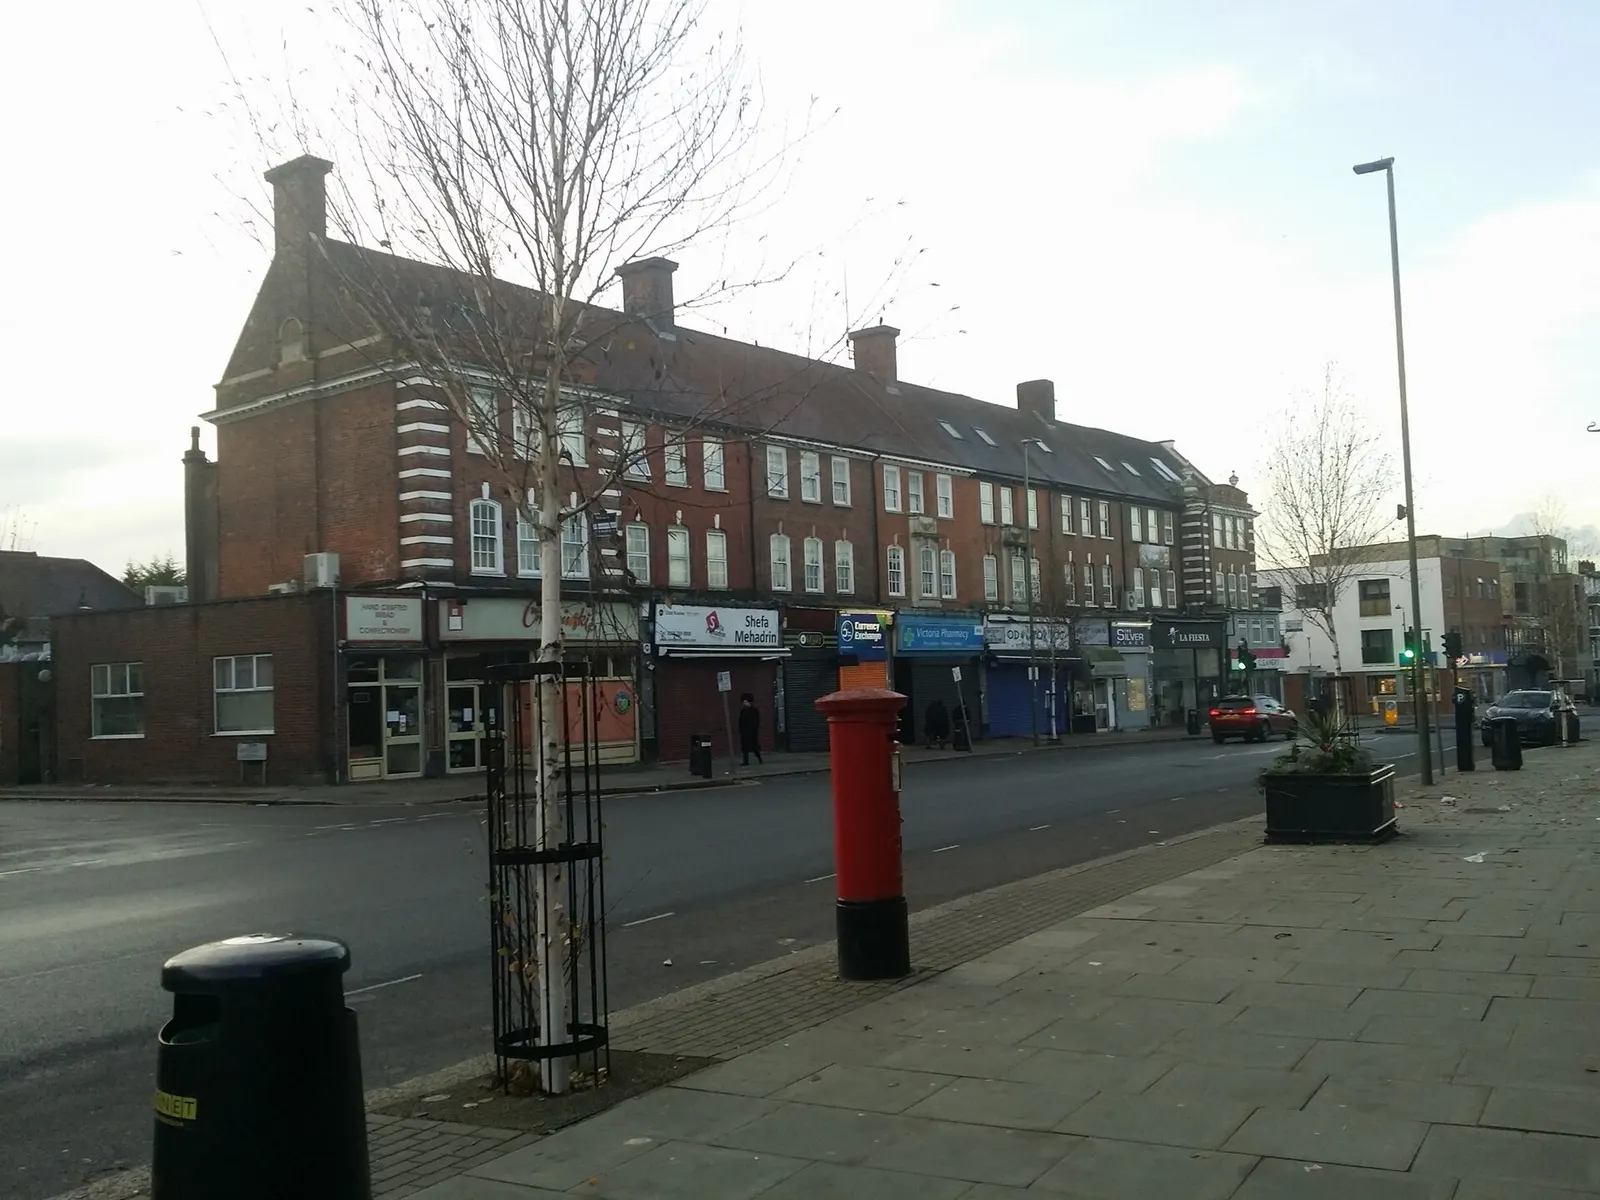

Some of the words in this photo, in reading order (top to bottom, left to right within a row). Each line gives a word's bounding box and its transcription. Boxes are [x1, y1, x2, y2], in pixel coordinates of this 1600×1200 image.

[361, 603, 379, 611] HAND
[745, 615, 769, 628] Shefa
[854, 621, 880, 632] Currency
[734, 630, 777, 643] Mehadrin
[854, 632, 882, 642] Exchange
[916, 627, 940, 638] Victoria
[941, 628, 970, 640] Pharmacy
[1116, 629, 1144, 641] SILVER
[1179, 633, 1188, 641] LA
[1188, 633, 1210, 642] FIESTA
[1457, 693, 1464, 702] P
